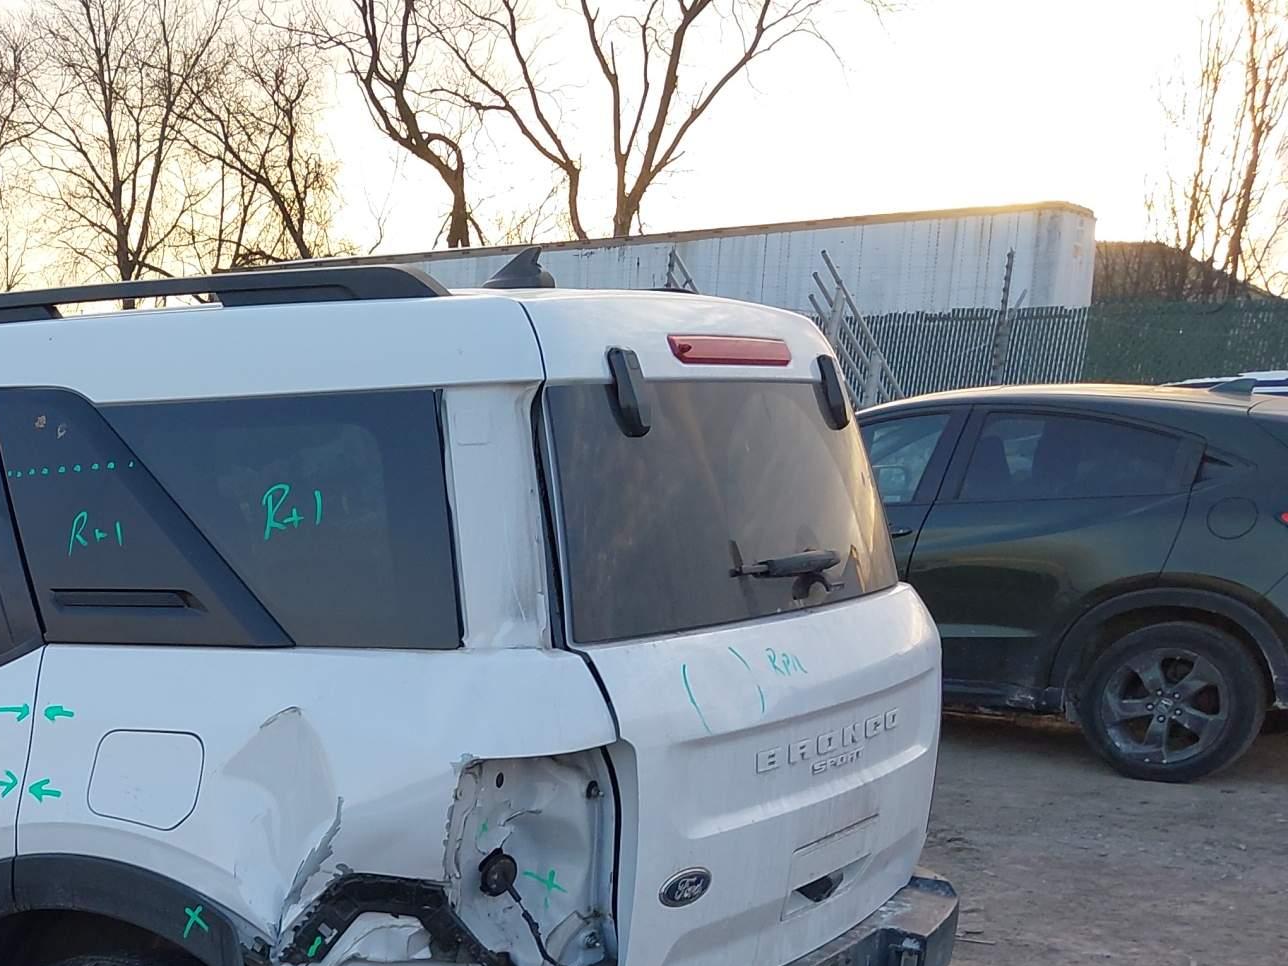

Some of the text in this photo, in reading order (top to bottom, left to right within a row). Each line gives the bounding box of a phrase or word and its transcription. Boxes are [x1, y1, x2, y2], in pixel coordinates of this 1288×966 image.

[756, 707, 900, 774] BRONCO
[811, 747, 864, 775] SPORT
[674, 876, 705, 900] Ford
